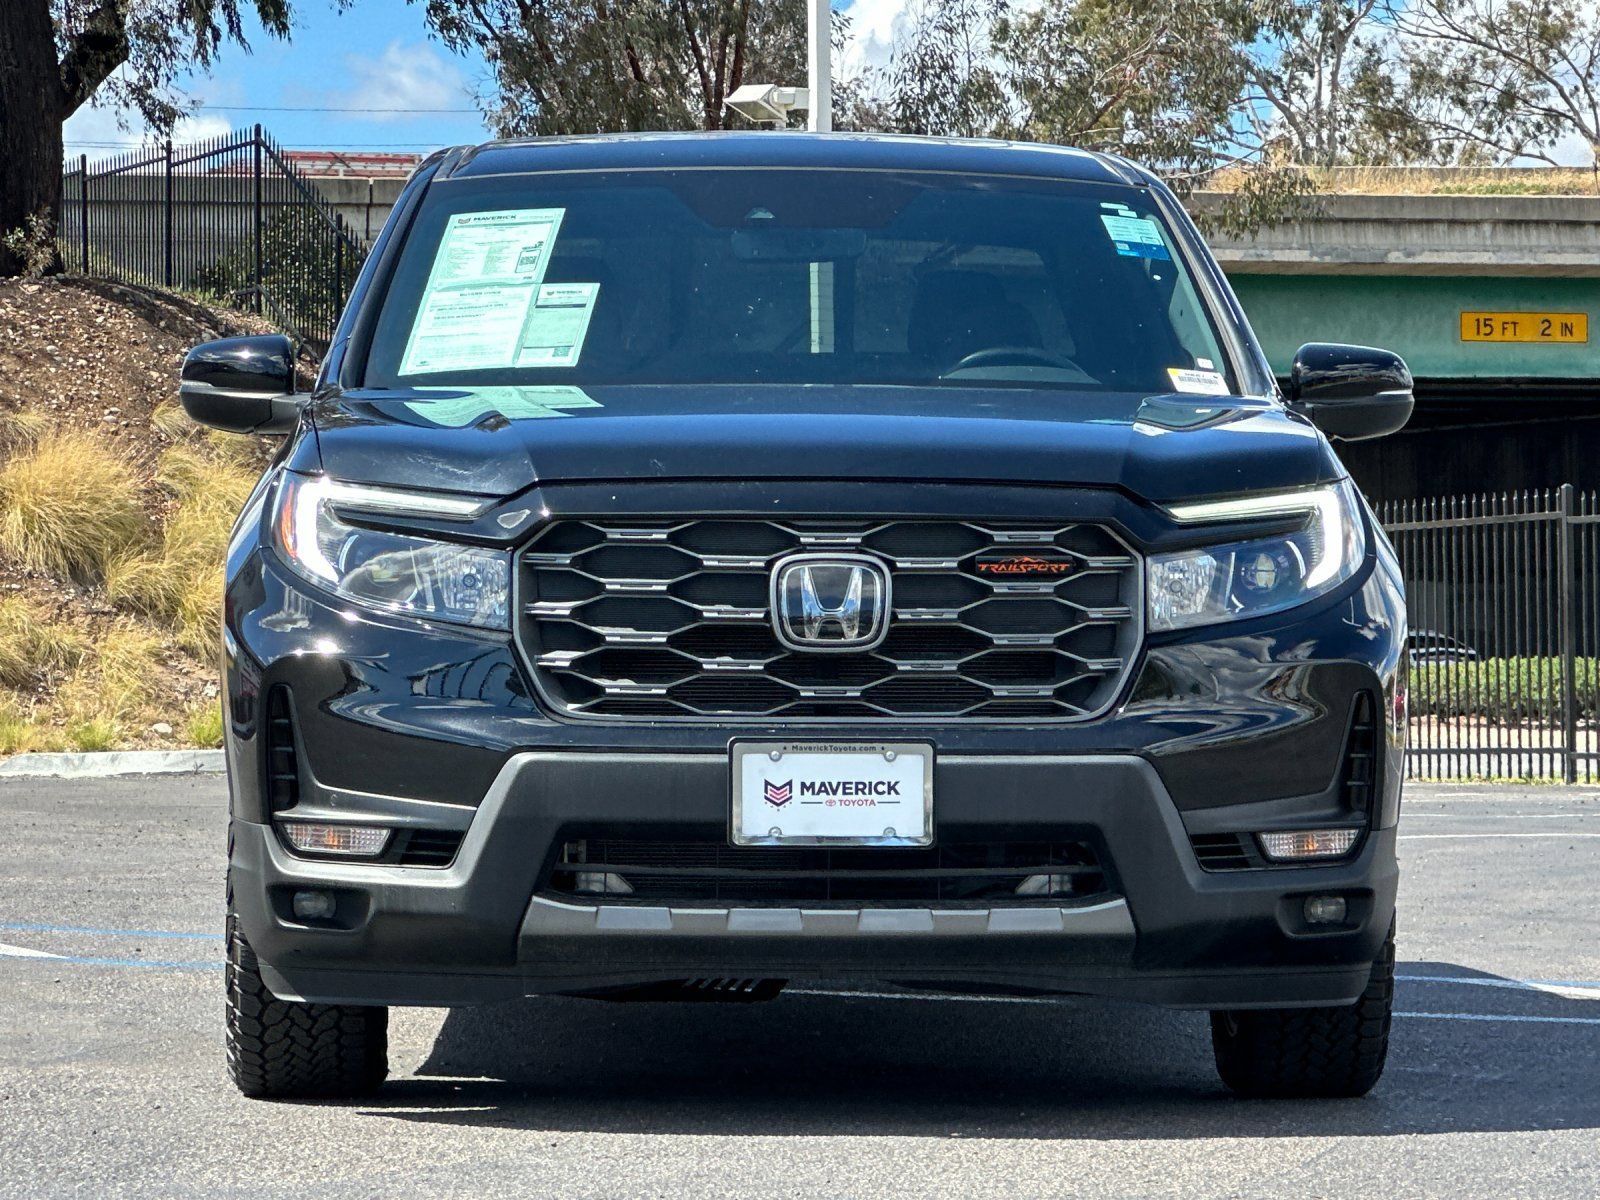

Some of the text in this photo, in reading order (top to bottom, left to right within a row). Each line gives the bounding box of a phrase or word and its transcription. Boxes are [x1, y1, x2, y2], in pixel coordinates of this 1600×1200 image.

[1475, 318, 1573, 337] 15 FT 2 IN
[978, 563, 1070, 573] TRAILSPORT
[791, 744, 877, 753] MaverickToyota.com
[800, 780, 901, 796] MAVERICK
[839, 799, 877, 807] TOYOTA
